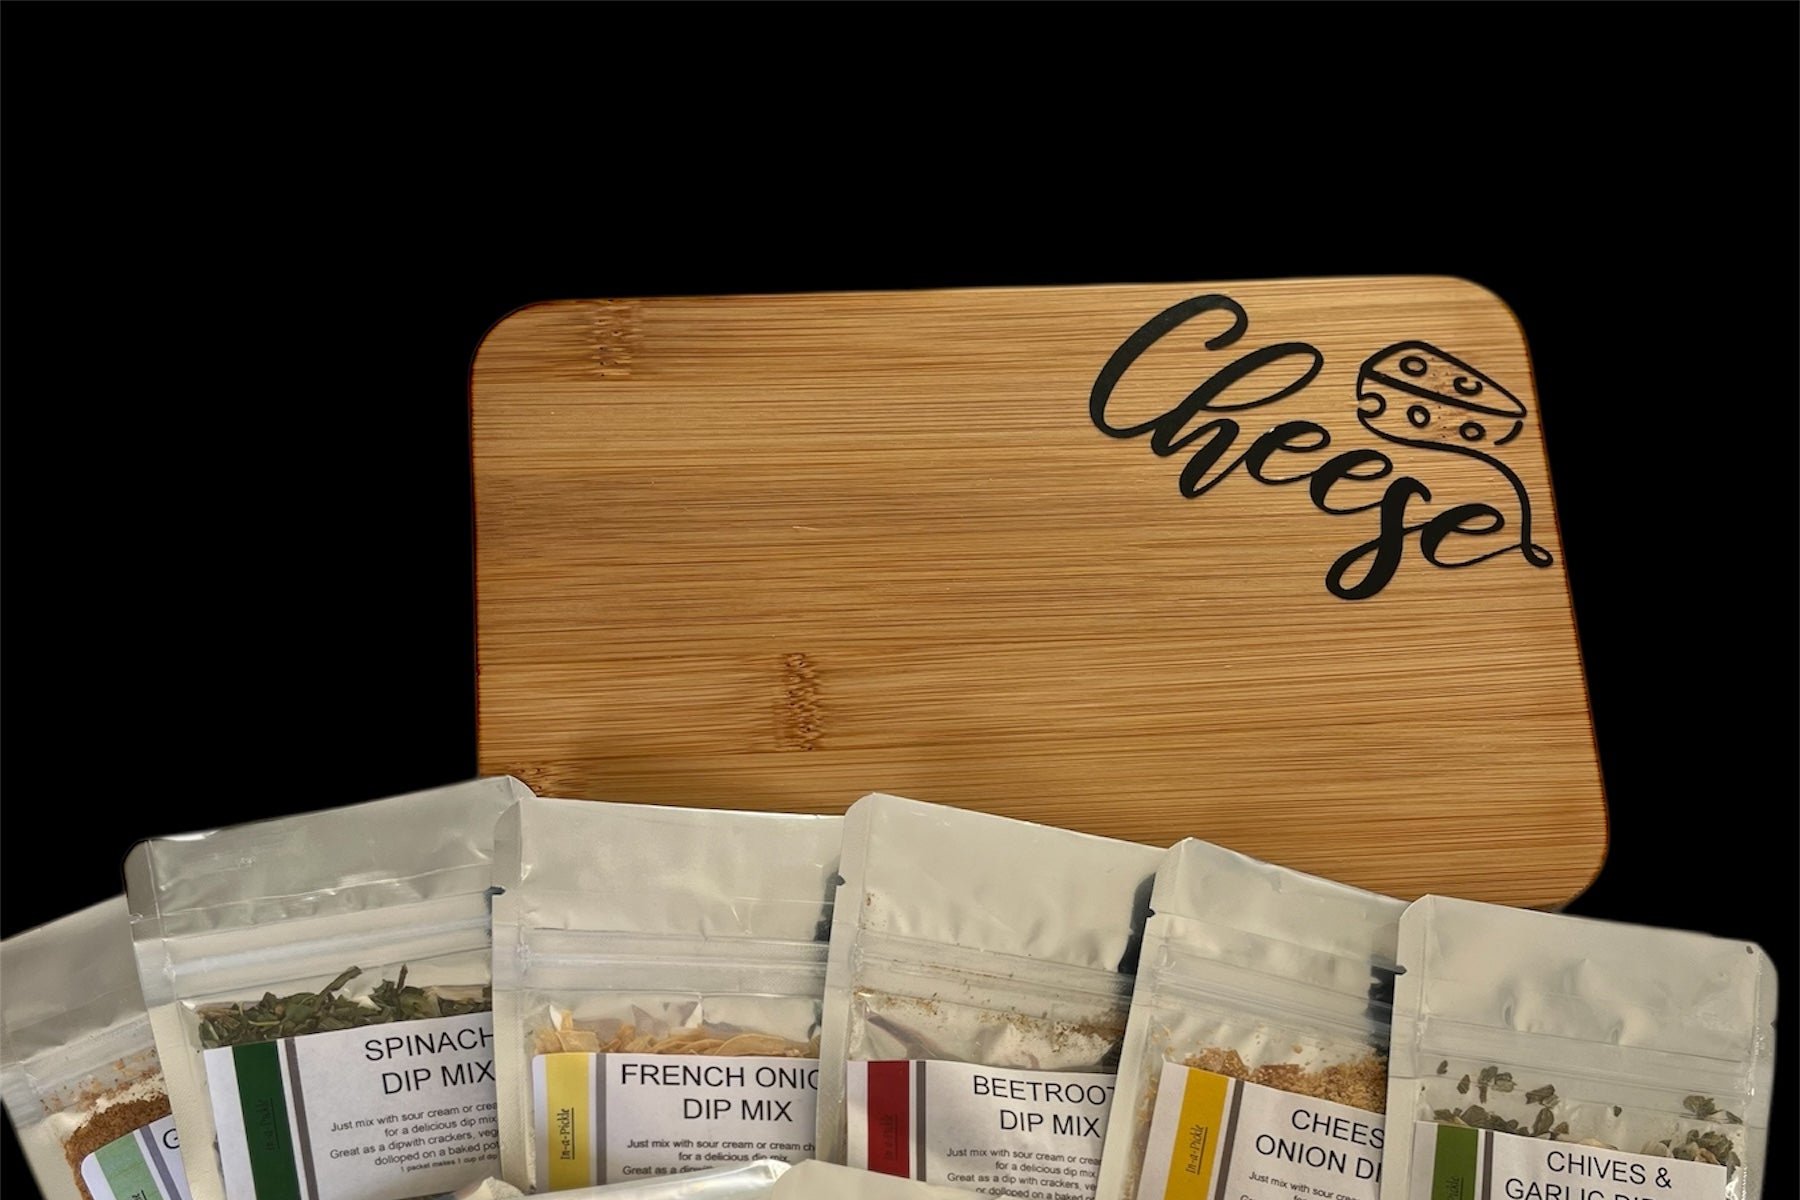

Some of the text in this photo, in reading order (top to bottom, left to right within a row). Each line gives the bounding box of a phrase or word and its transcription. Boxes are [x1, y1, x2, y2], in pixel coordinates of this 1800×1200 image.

[1090, 293, 1553, 600] Cheese
[382, 1060, 495, 1094] DIP MIX
[622, 1064, 744, 1087] FRENCH
[331, 1121, 353, 1132] Just
[355, 1119, 375, 1128] mix
[376, 1114, 399, 1125] with
[401, 1111, 424, 1122] sour
[427, 1107, 460, 1118] cream
[462, 1105, 473, 1114] or
[684, 1098, 792, 1122] DIP MIX
[384, 1118, 477, 1137] for a delicious dip
[557, 1107, 572, 1160] In-a-Pickle
[1000, 1109, 1100, 1138] DIP MIX
[1292, 1109, 1385, 1150] CHEES
[329, 1147, 360, 1159] Great
[362, 1145, 376, 1155] as
[378, 1143, 386, 1152] a
[627, 1139, 649, 1149] Just
[651, 1139, 670, 1148] mix
[672, 1139, 694, 1148] with
[696, 1140, 719, 1149] sour
[721, 1141, 754, 1149] cream
[755, 1142, 767, 1150] or
[769, 1142, 801, 1151] cream
[678, 1152, 749, 1162] for a delicious
[946, 1148, 968, 1157] Just
[969, 1149, 988, 1157] mix
[989, 1149, 1010, 1157] with
[1012, 1151, 1033, 1159] sour
[1035, 1153, 1065, 1162] cream
[1066, 1155, 1077, 1164] or
[1185, 1124, 1206, 1175] In-a-Pickle
[1256, 1134, 1346, 1173] ONION
[622, 1165, 652, 1176] Great
[654, 1167, 667, 1176] as
[995, 1160, 1078, 1178] for a delicious dip
[1547, 1151, 1672, 1189] CHIVES &
